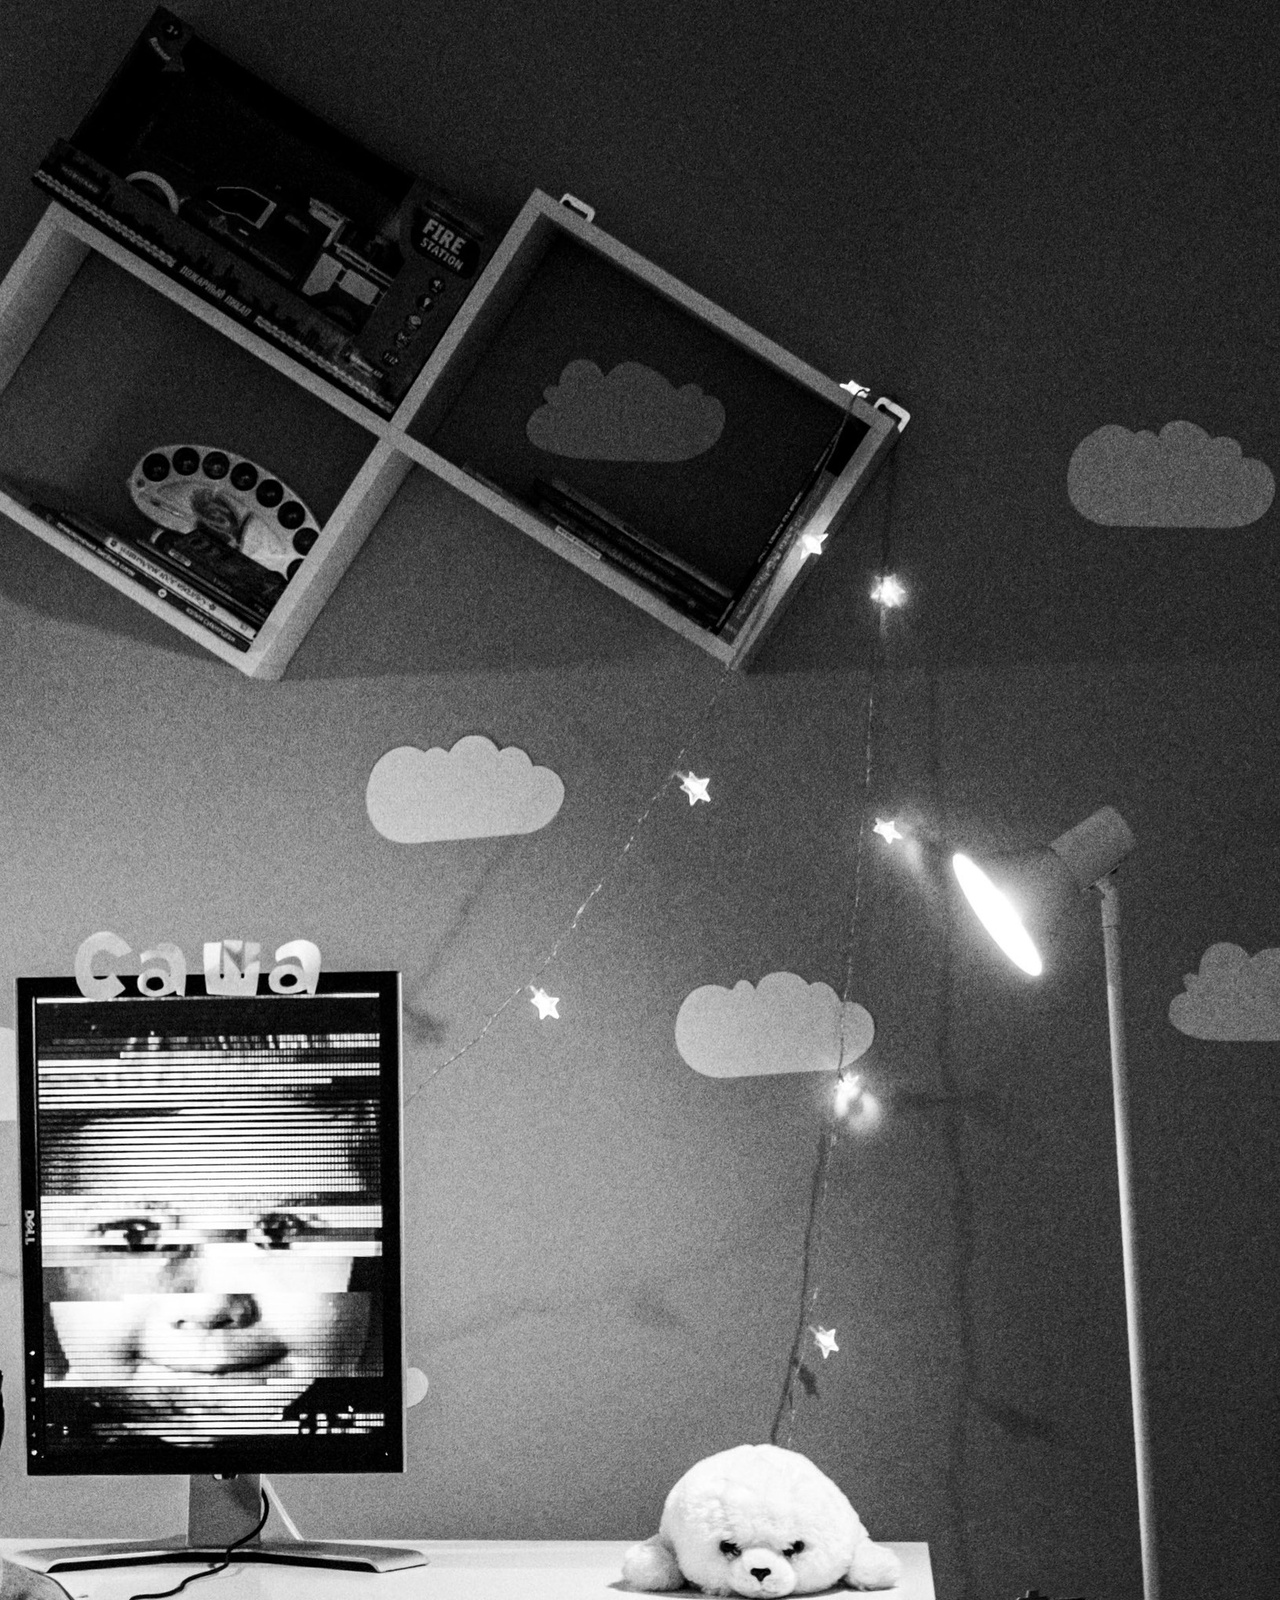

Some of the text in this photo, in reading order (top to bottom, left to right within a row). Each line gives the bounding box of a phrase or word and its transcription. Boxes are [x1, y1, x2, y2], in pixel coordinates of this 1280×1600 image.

[420, 236, 465, 272] STATION
[422, 218, 467, 256] FIRE
[179, 265, 253, 317] ПОЖАРНЫЙ ПИКАП
[24, 1209, 36, 1246] DELL
